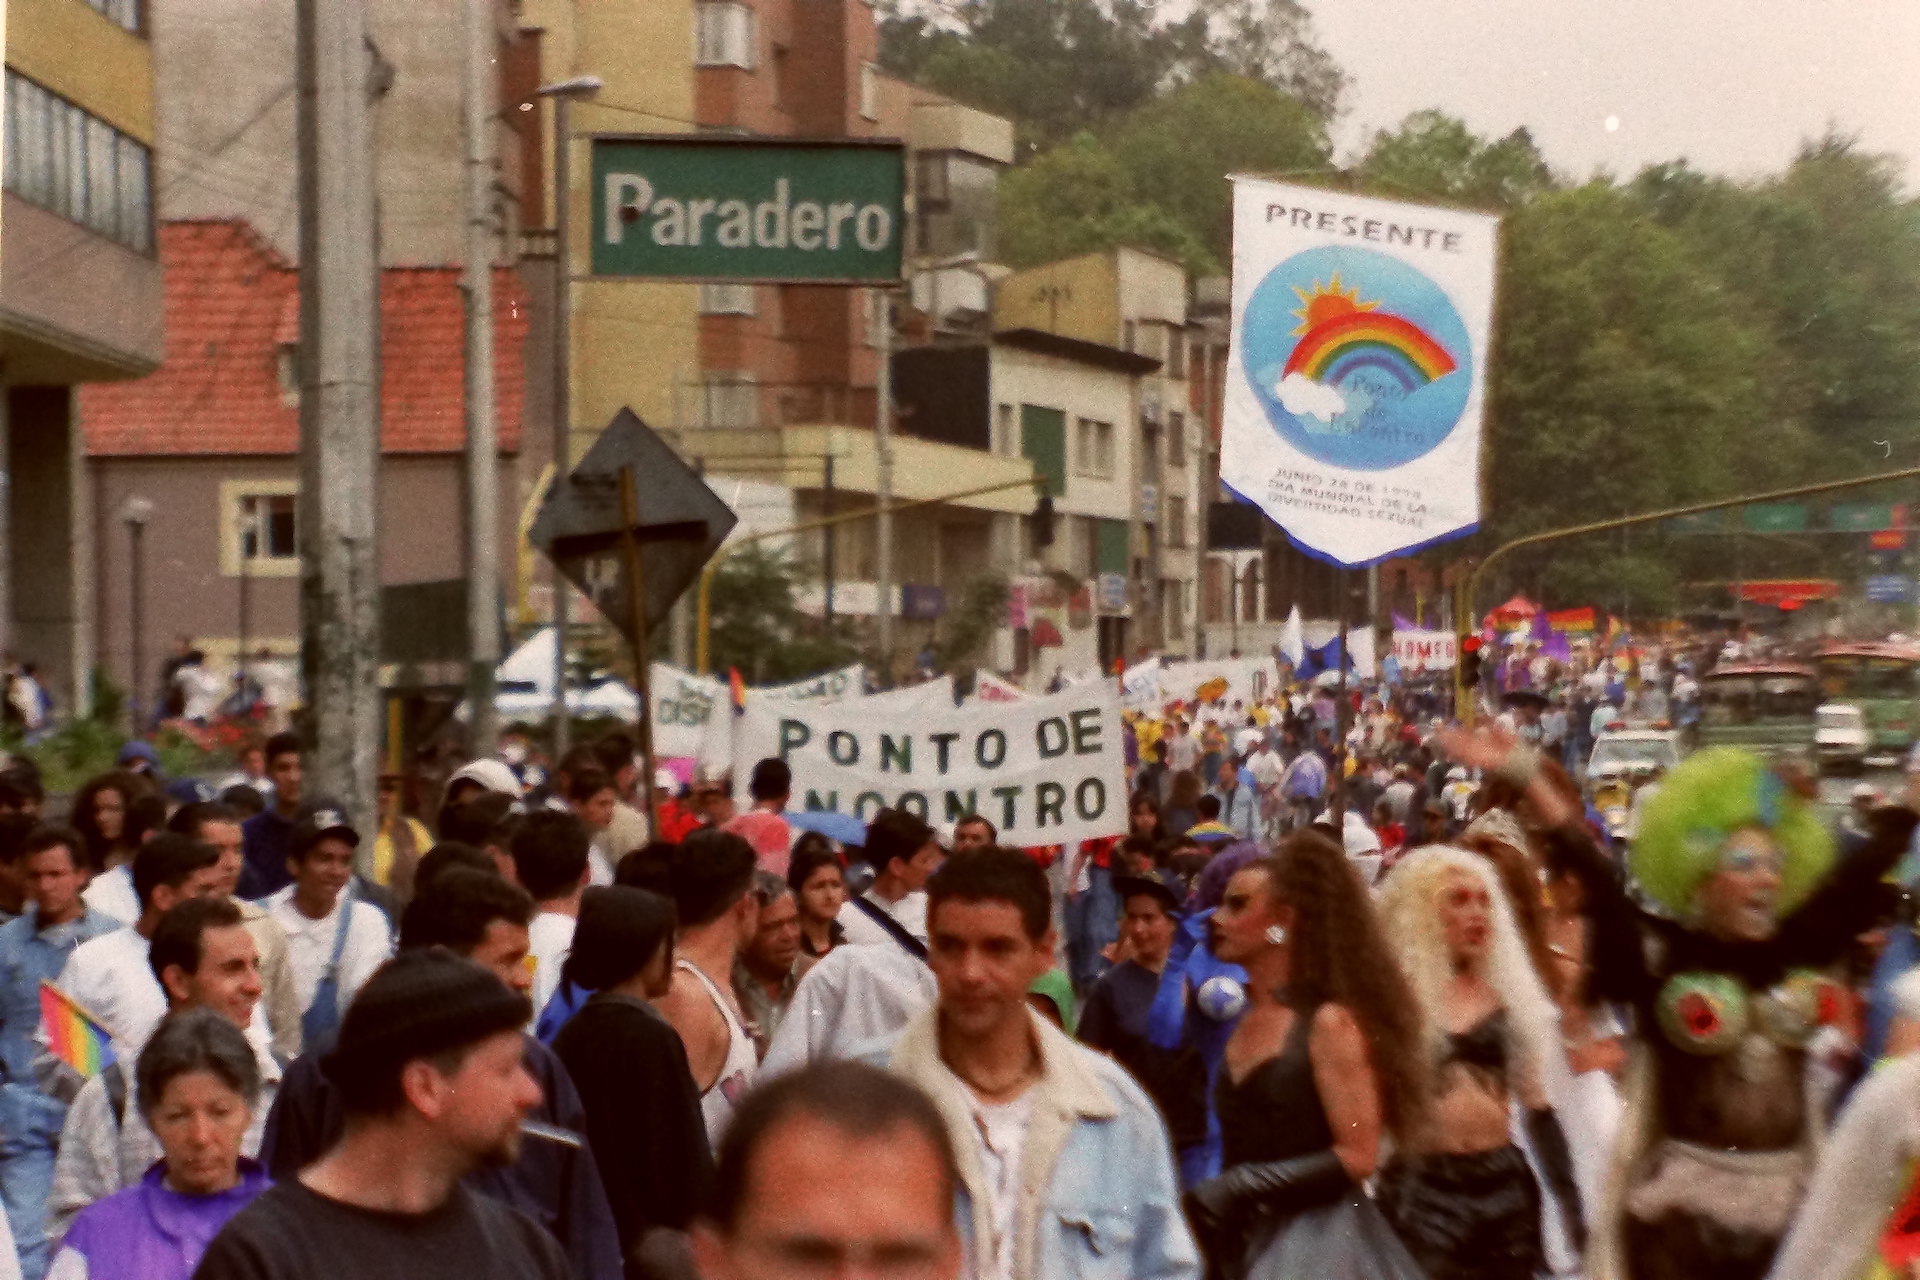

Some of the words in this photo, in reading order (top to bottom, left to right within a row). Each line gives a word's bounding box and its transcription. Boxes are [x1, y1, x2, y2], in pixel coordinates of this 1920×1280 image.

[604, 173, 892, 252] Paradero
[1265, 202, 1463, 253] PRESENTE
[1275, 467, 1323, 486] JUNIO
[1300, 486, 1376, 507] MUNDIAL
[1406, 501, 1428, 516] LA
[779, 718, 1007, 775] PONTO
[1036, 708, 1104, 759] DE
[804, 776, 1107, 830] NCONTRO
